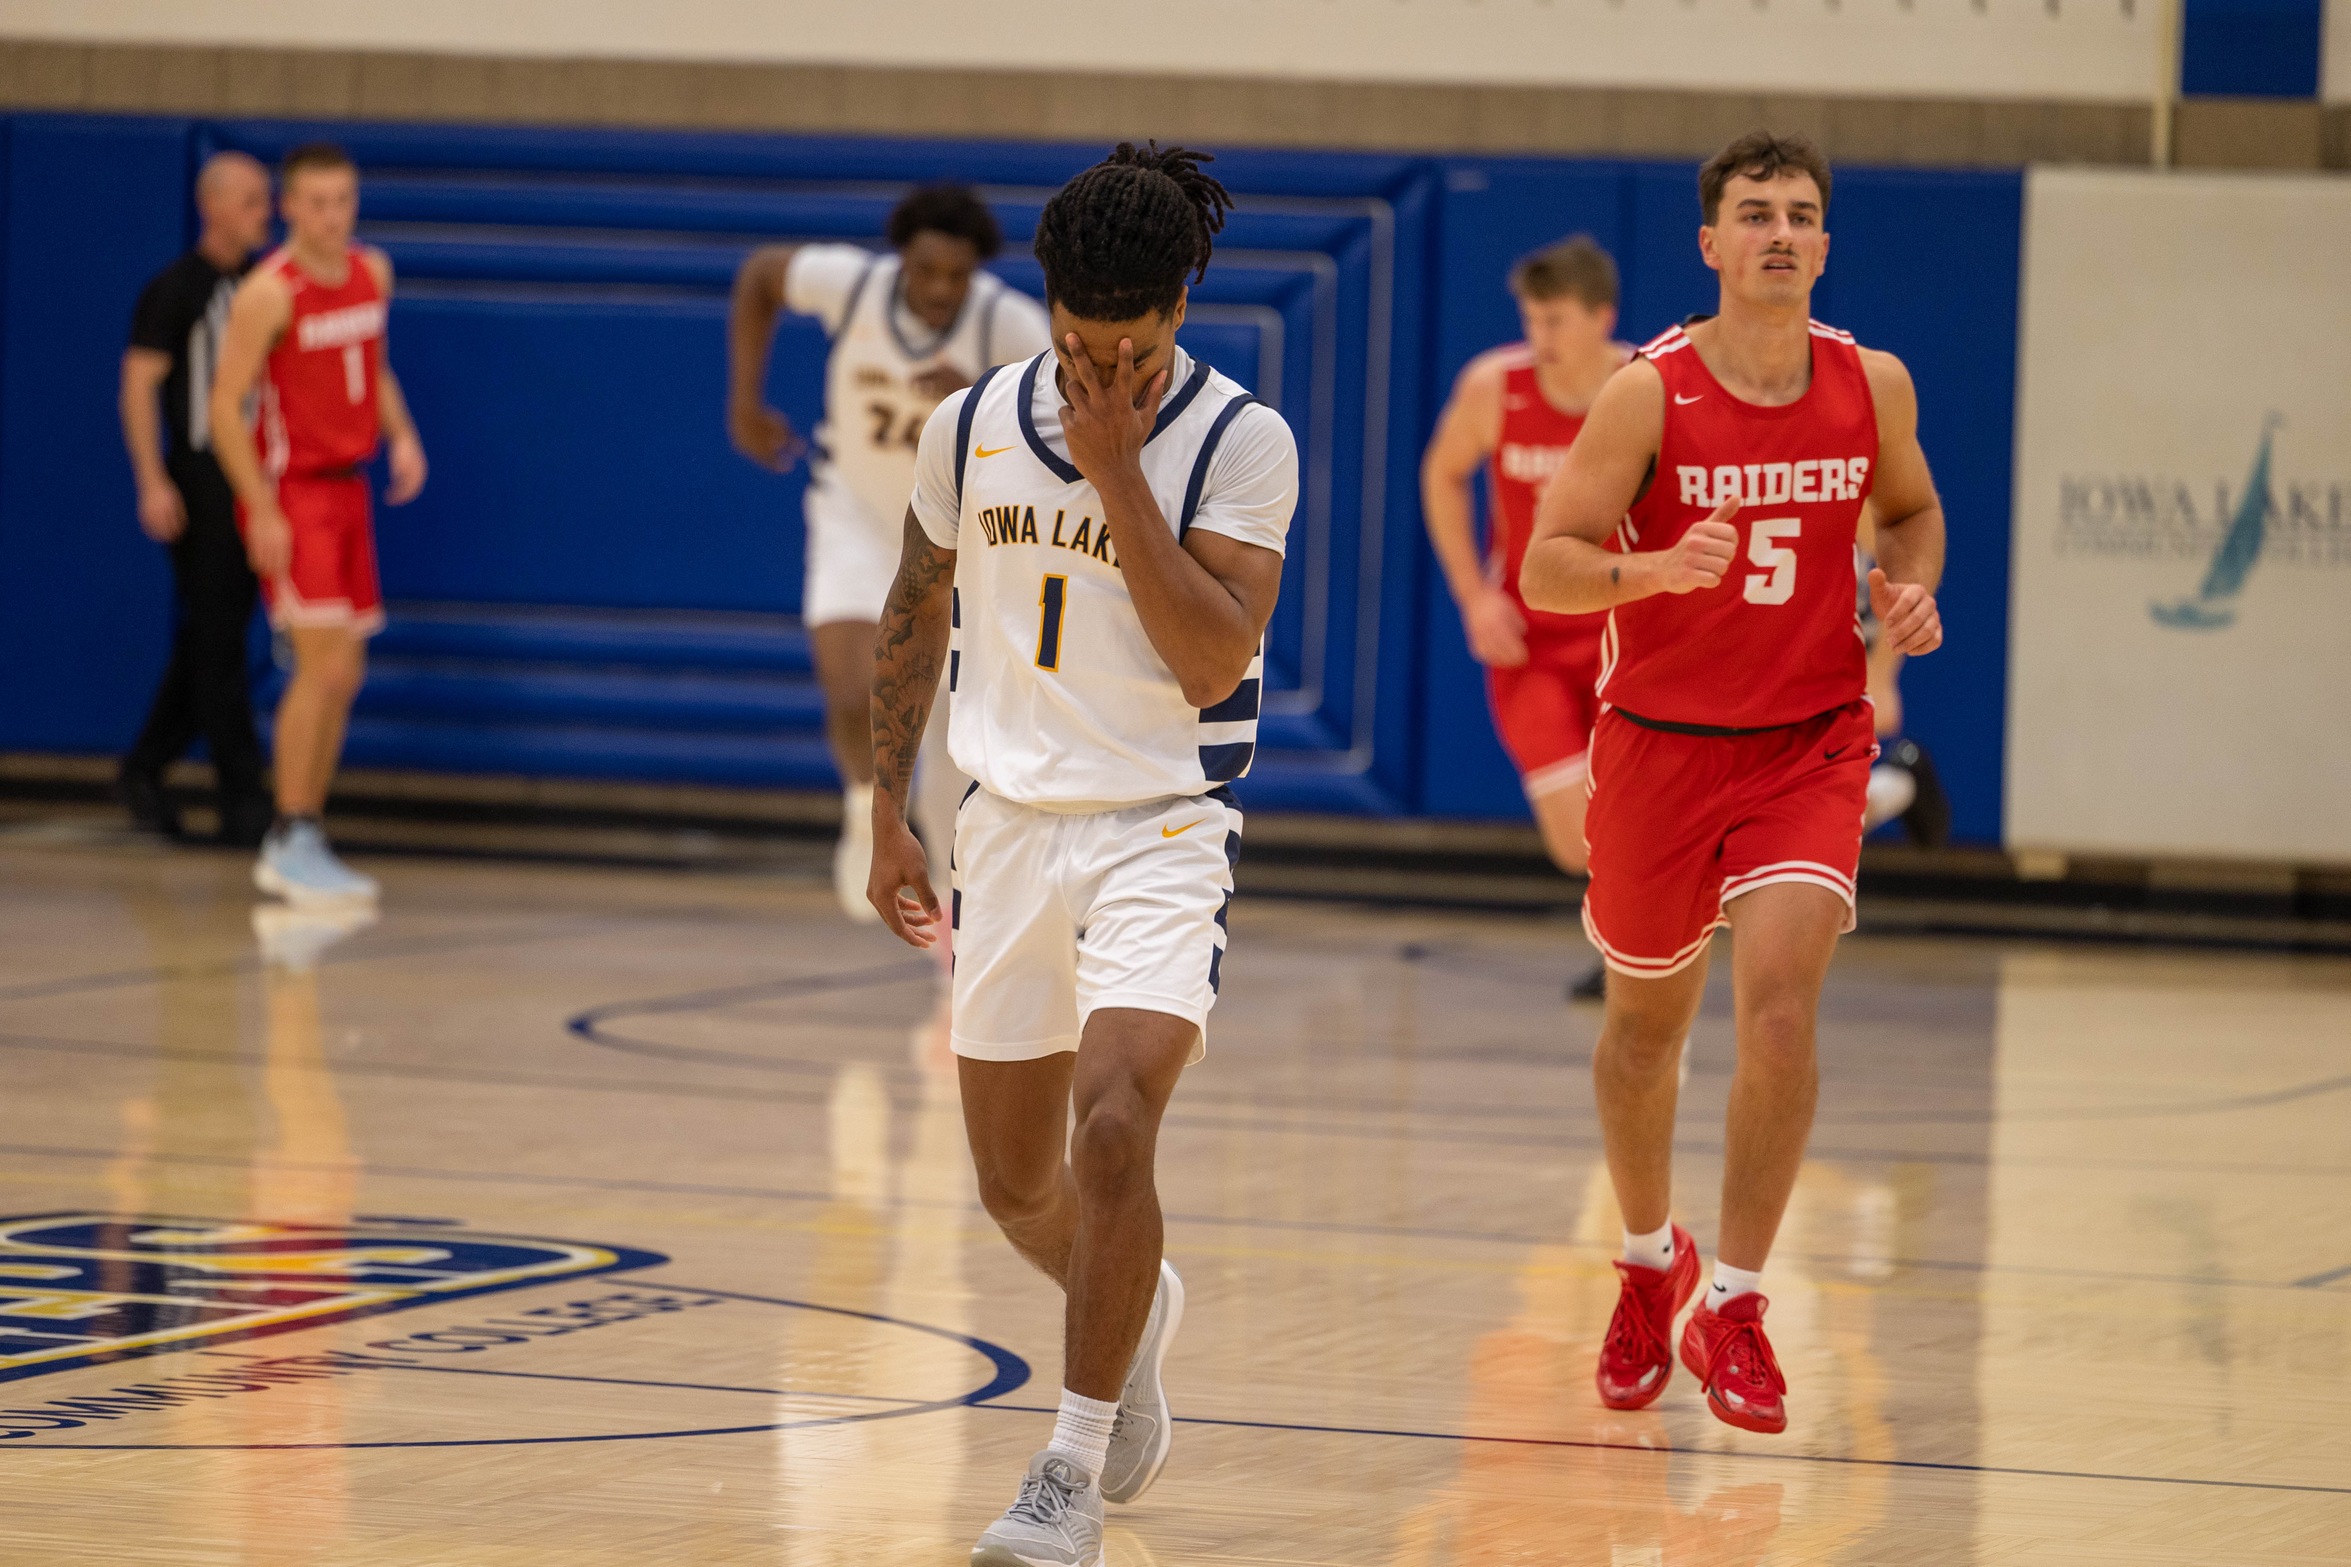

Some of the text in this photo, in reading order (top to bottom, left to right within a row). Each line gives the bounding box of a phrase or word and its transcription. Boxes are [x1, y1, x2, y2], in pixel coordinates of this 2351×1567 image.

[342, 343, 367, 404] 1
[1676, 456, 1869, 508] RAIDERS
[1051, 509, 1121, 569] LAK
[1742, 517, 1801, 605] 5
[1034, 573, 1068, 673] 1
